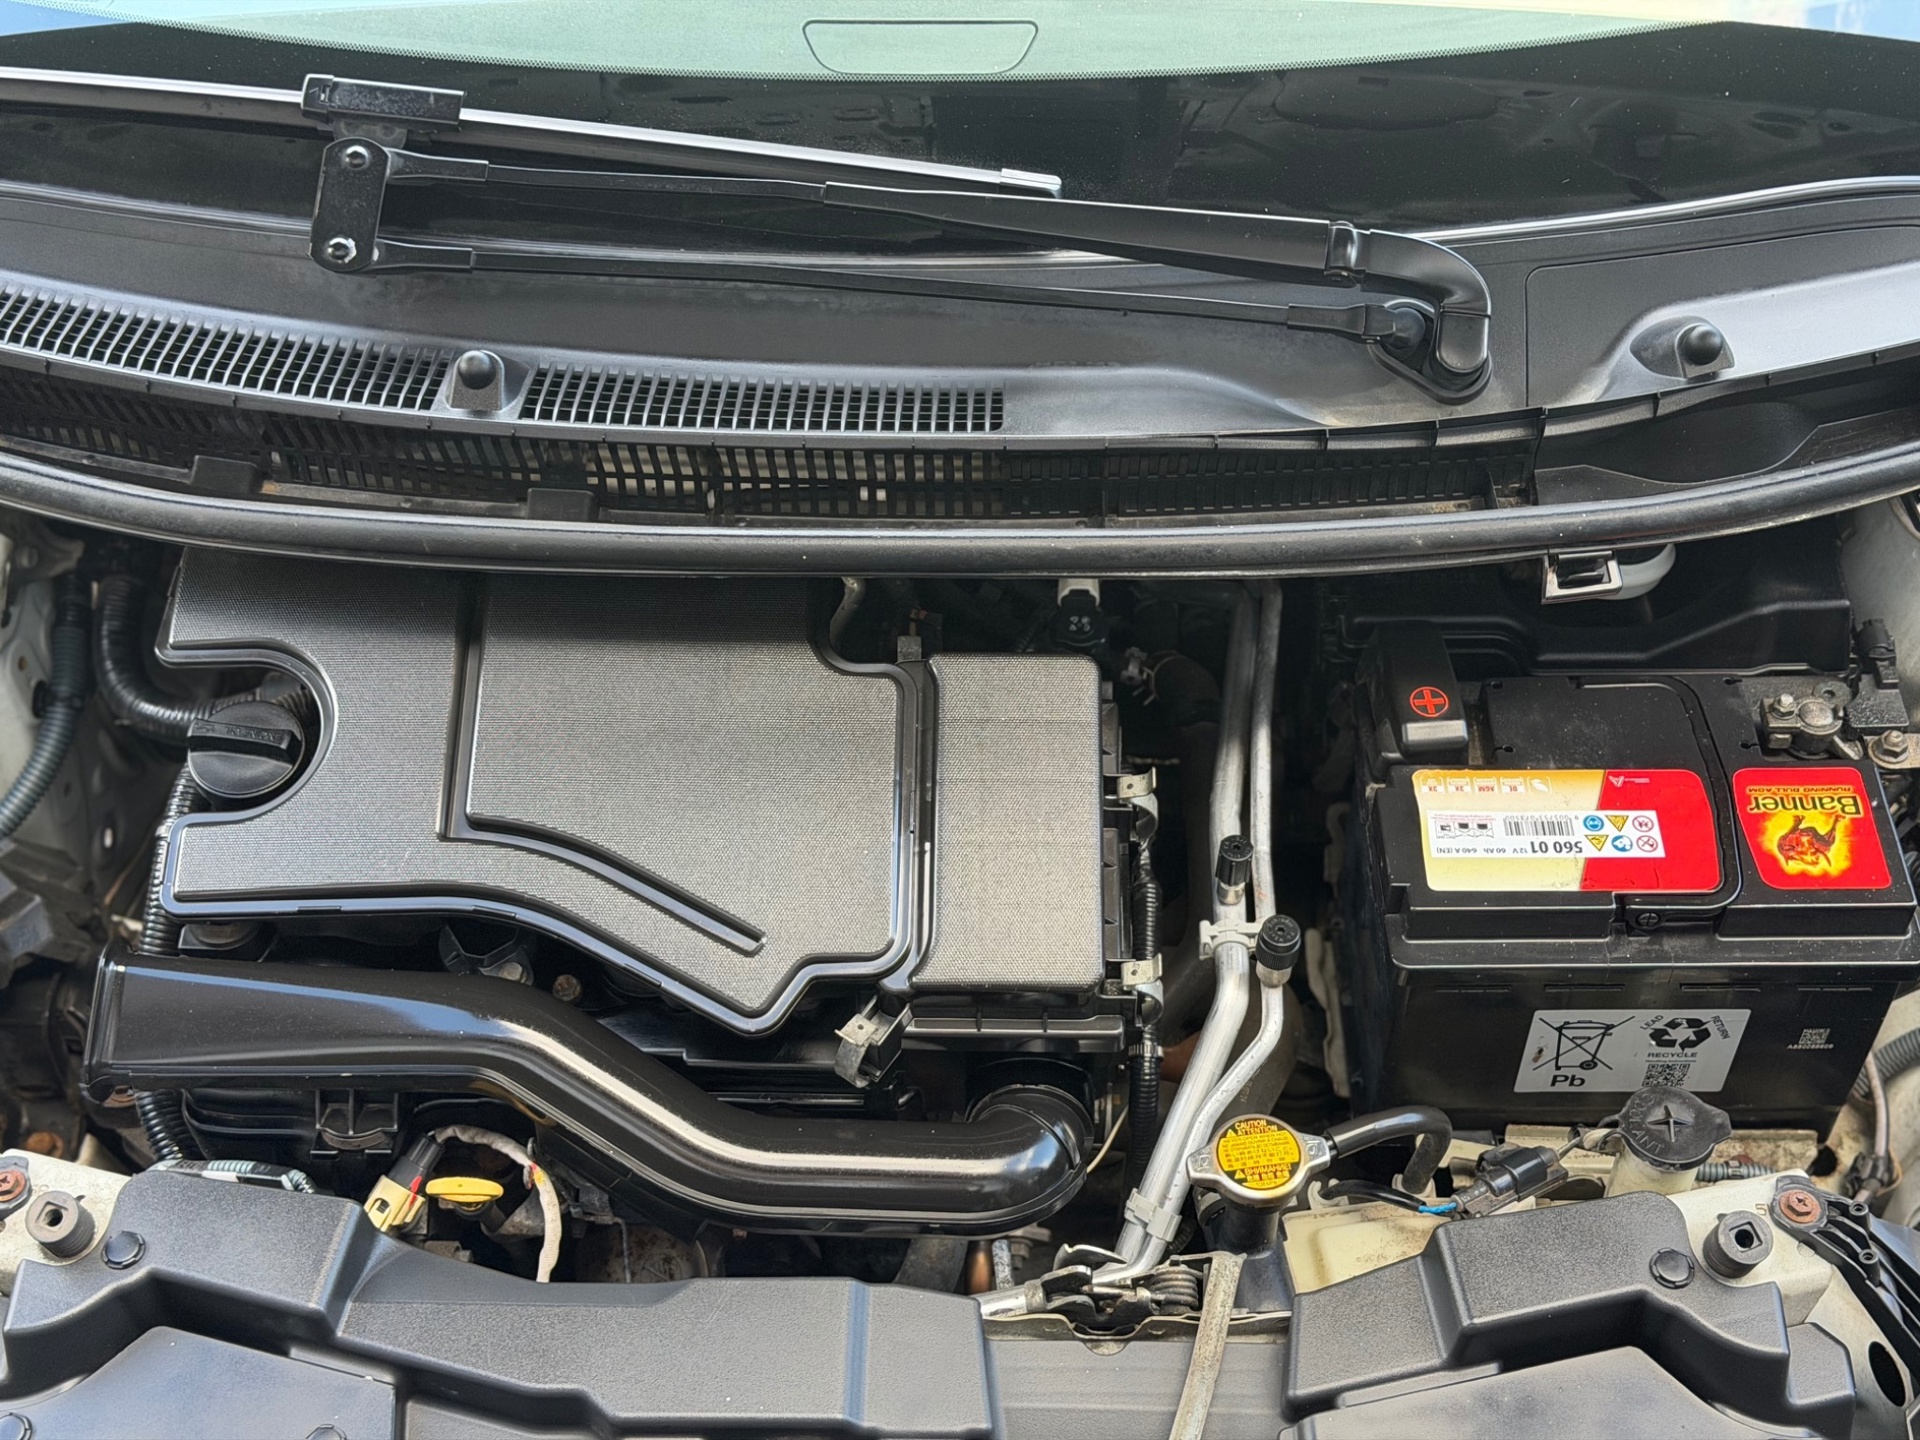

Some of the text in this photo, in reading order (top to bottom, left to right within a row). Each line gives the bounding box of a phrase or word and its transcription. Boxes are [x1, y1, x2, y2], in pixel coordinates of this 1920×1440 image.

[1749, 795, 1862, 815] Banner
[1530, 841, 1549, 854] 01
[1553, 841, 1583, 854] 560
[1639, 1015, 1664, 1030] LEAD
[1710, 1015, 1731, 1040] RETURN
[1550, 1074, 1586, 1087] Pb
[1234, 1119, 1267, 1130] CAUTION
[1237, 1125, 1278, 1136] ATTENTION
